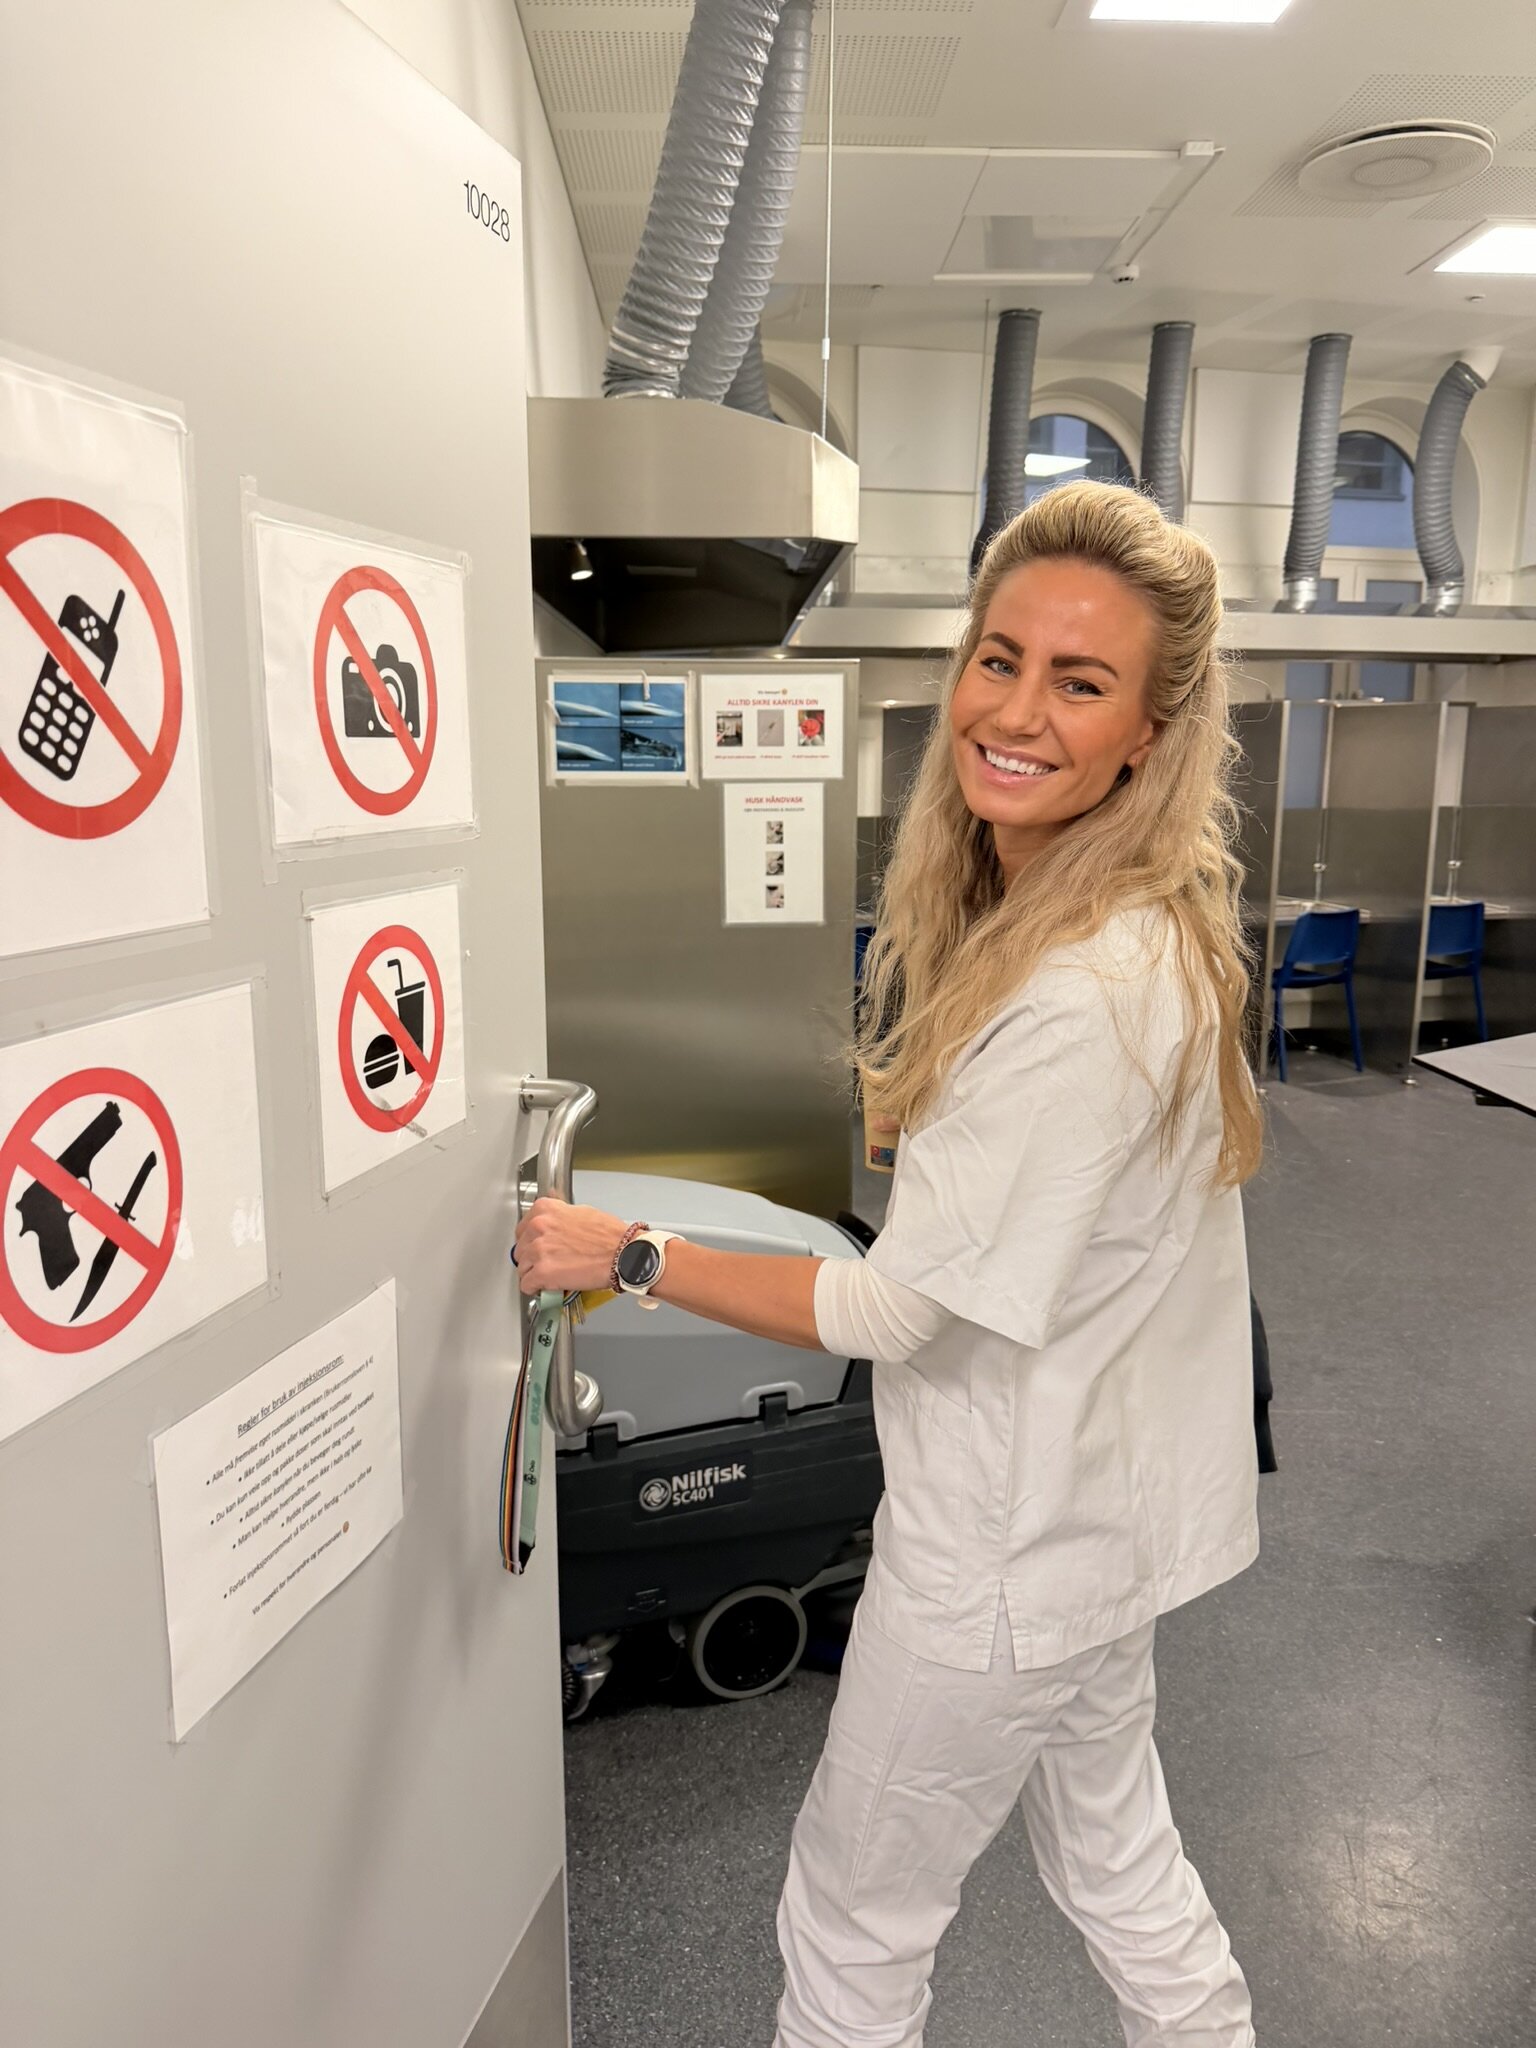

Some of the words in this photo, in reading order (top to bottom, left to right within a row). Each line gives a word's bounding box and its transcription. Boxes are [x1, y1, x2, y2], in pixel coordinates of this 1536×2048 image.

[463, 179, 511, 243] 10028
[727, 698, 751, 706] ALLTID
[752, 698, 770, 706] SIKRE
[772, 698, 804, 706] KANYLEN
[805, 698, 819, 706] DIN
[745, 796, 764, 804] HUSK
[766, 795, 803, 804] HÅNDVASK
[237, 1413, 260, 1435] Regler
[260, 1404, 271, 1418] for
[272, 1392, 287, 1410] bruk
[288, 1386, 296, 1398] av
[672, 1463, 747, 1492] Nilfisk
[672, 1485, 715, 1507] SC401
